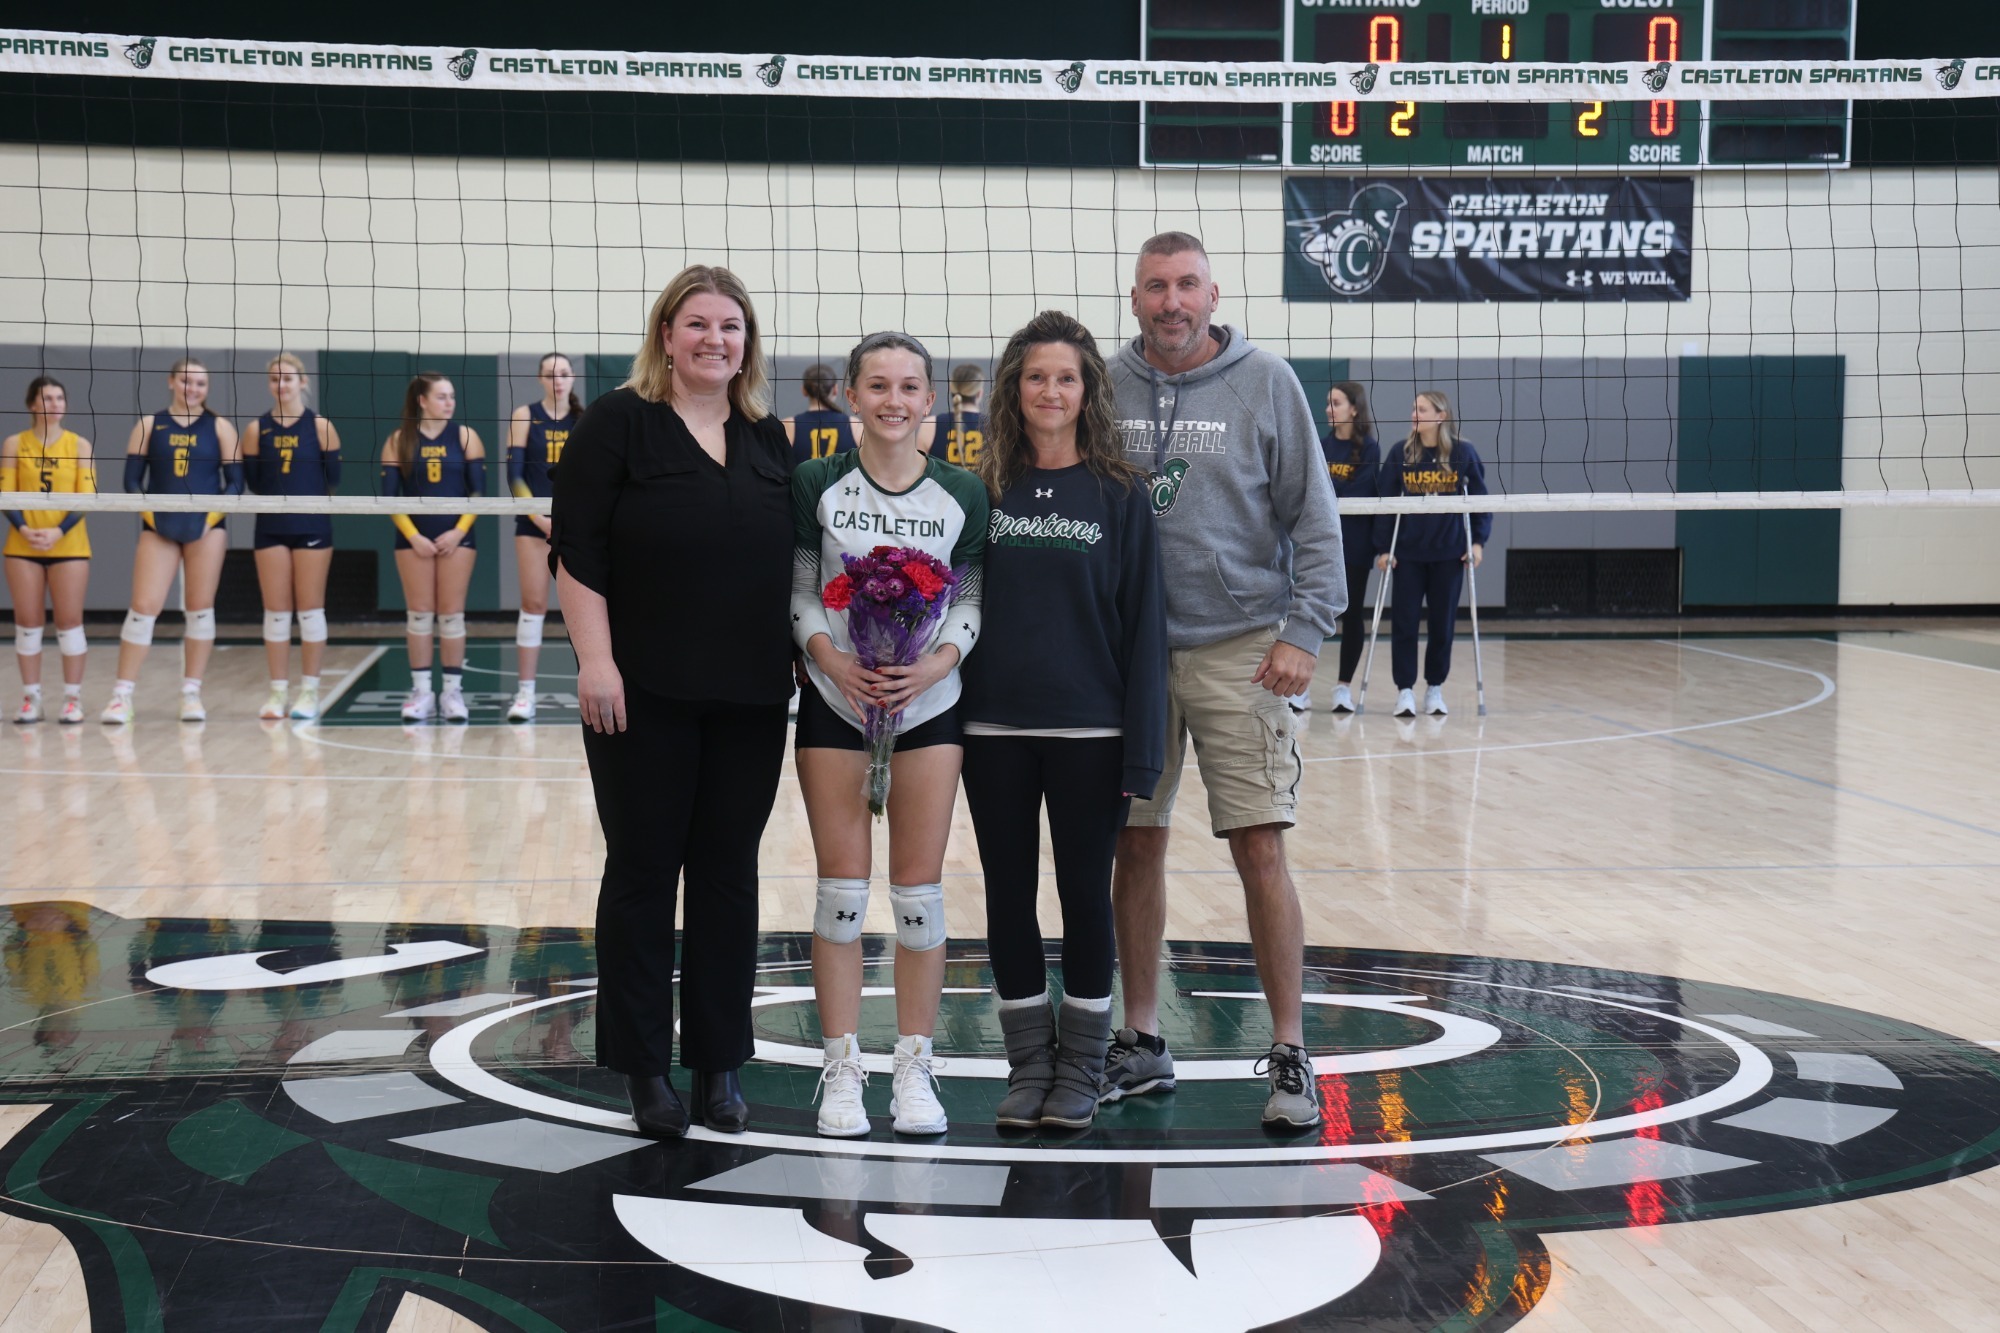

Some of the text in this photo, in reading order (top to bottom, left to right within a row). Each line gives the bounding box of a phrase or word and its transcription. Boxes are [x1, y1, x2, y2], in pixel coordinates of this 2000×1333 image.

[1471, 0, 1529, 15] PERIOD
[1370, 15, 1399, 63] 0
[1502, 25, 1511, 60] 1
[1648, 15, 1678, 62] 0
[168, 45, 433, 72] CASTLETON SPARTANS
[489, 57, 743, 79] CASTLETON SPARTANS
[797, 64, 1042, 84] CASTLETON SPARTANS
[1096, 70, 1337, 87] CASTLETON SPARTANS
[1389, 68, 1629, 85] CASTLETON SPARTANS
[1681, 67, 1923, 84] CASTLETON SPARTANS
[1331, 100, 1355, 136] 0
[1390, 100, 1415, 136] 2
[1578, 100, 1602, 136] 2
[1650, 99, 1675, 136] 0
[1310, 144, 1362, 163] SCORE
[1467, 144, 1524, 163] MATCH
[1629, 144, 1681, 162] SCORE
[1446, 194, 1609, 217] CASTLETON
[1408, 220, 1675, 259] SPARTANS
[1598, 270, 1625, 285] WE
[273, 435, 299, 448] USM
[421, 446, 447, 458] USM
[809, 427, 839, 458] 17
[946, 429, 983, 464] 22
[280, 449, 293, 474] 7
[426, 458, 442, 483] 8
[40, 471, 52, 493] 5
[1155, 484, 1171, 507] C
[833, 510, 945, 538] CASTLETON
[987, 509, 1102, 544] Spartans
[1000, 536, 1089, 553] VOLLEYBALL
